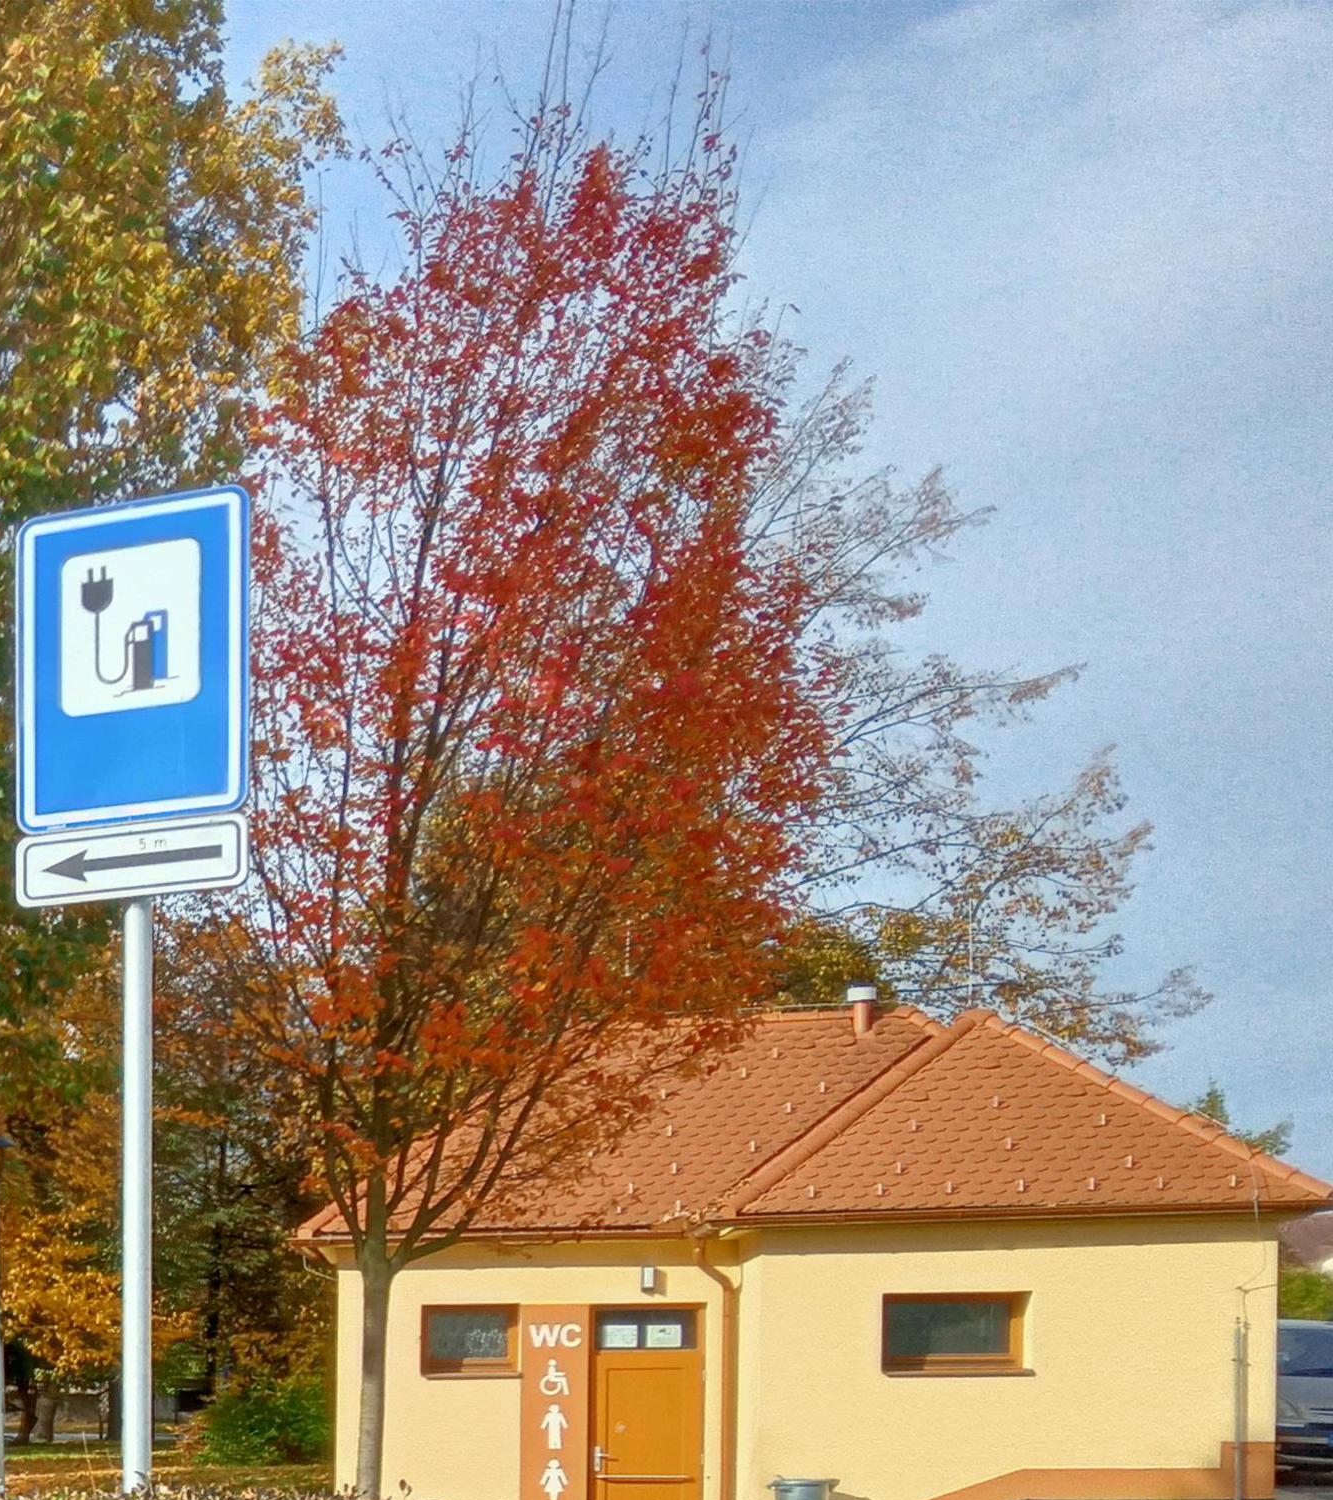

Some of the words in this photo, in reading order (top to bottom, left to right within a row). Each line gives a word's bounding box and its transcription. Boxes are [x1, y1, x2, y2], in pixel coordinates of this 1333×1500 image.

[139, 838, 146, 850] 5
[154, 838, 167, 849] m
[530, 1323, 582, 1347] WC
